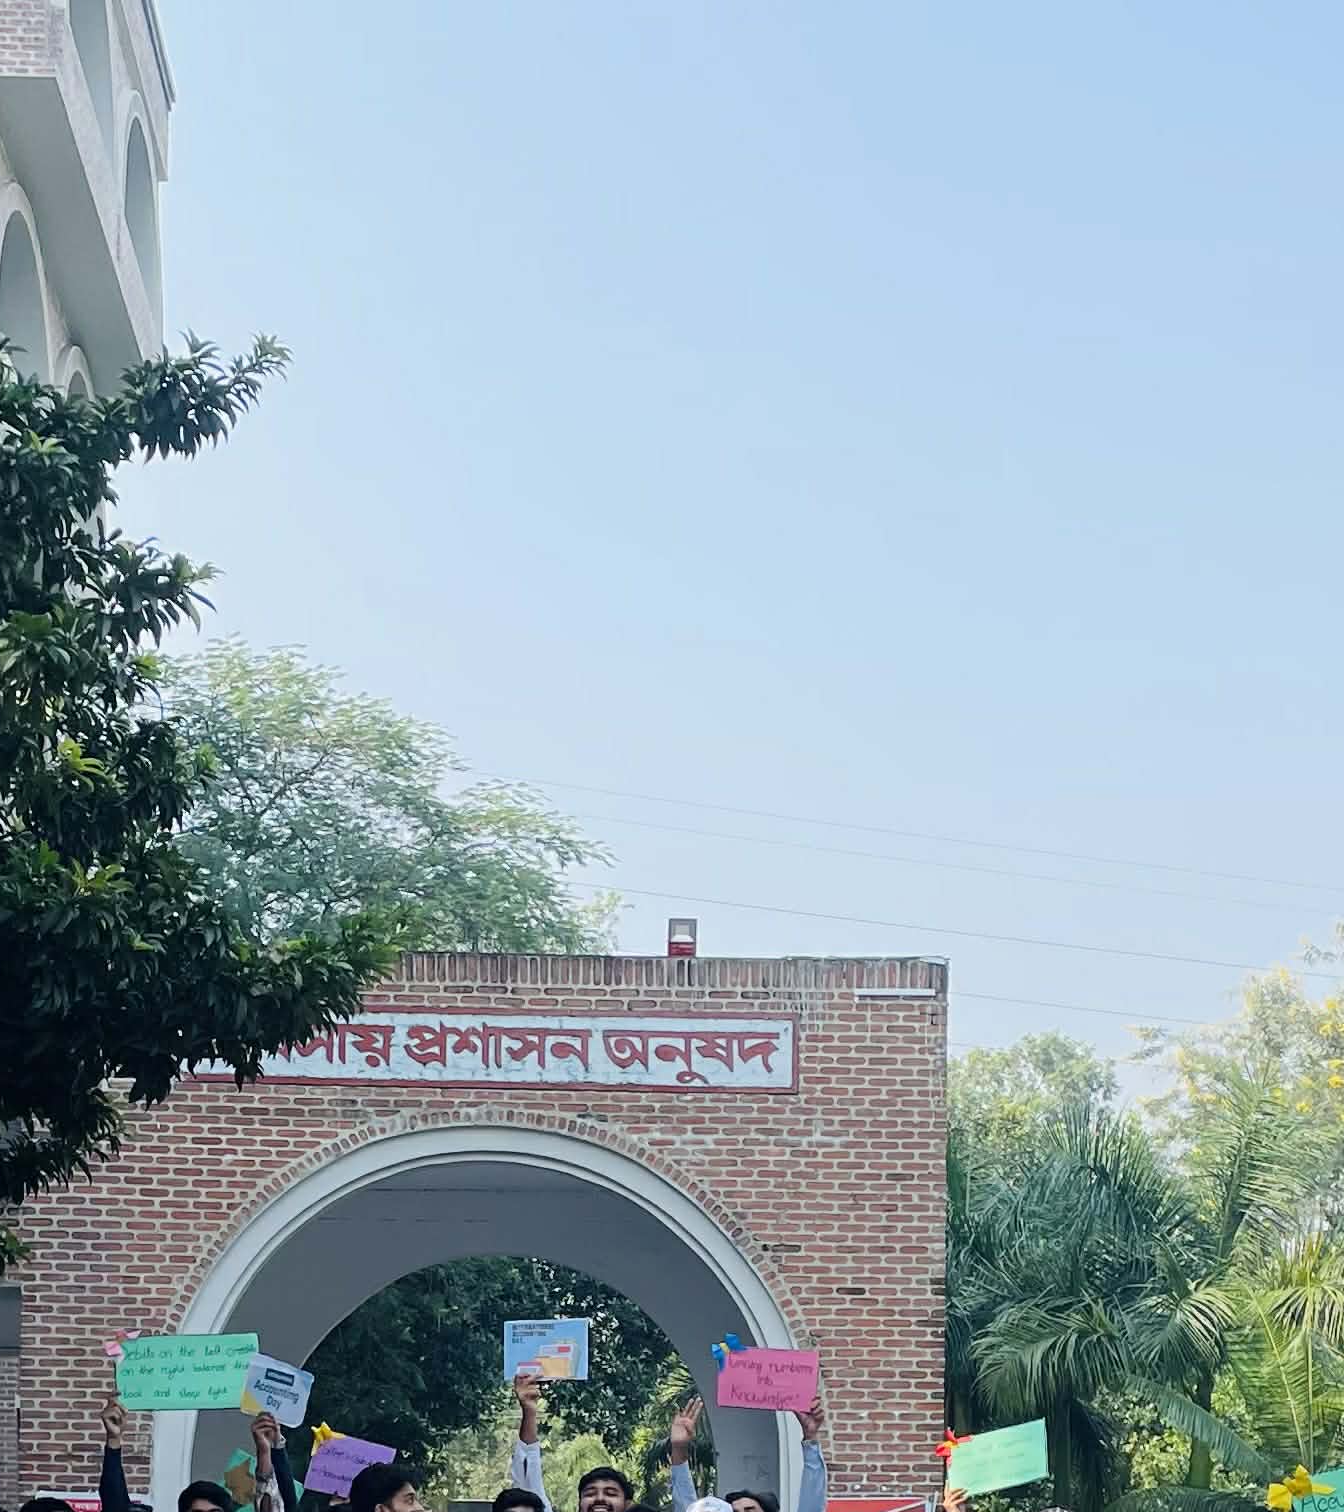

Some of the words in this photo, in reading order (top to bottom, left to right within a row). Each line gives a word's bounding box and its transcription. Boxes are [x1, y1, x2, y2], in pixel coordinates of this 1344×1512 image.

[404, 1022, 594, 1069] প্রশাসন
[602, 1029, 780, 1085] অনুষদ
[253, 1378, 300, 1405] Accounting
[264, 1394, 283, 1409] Day
